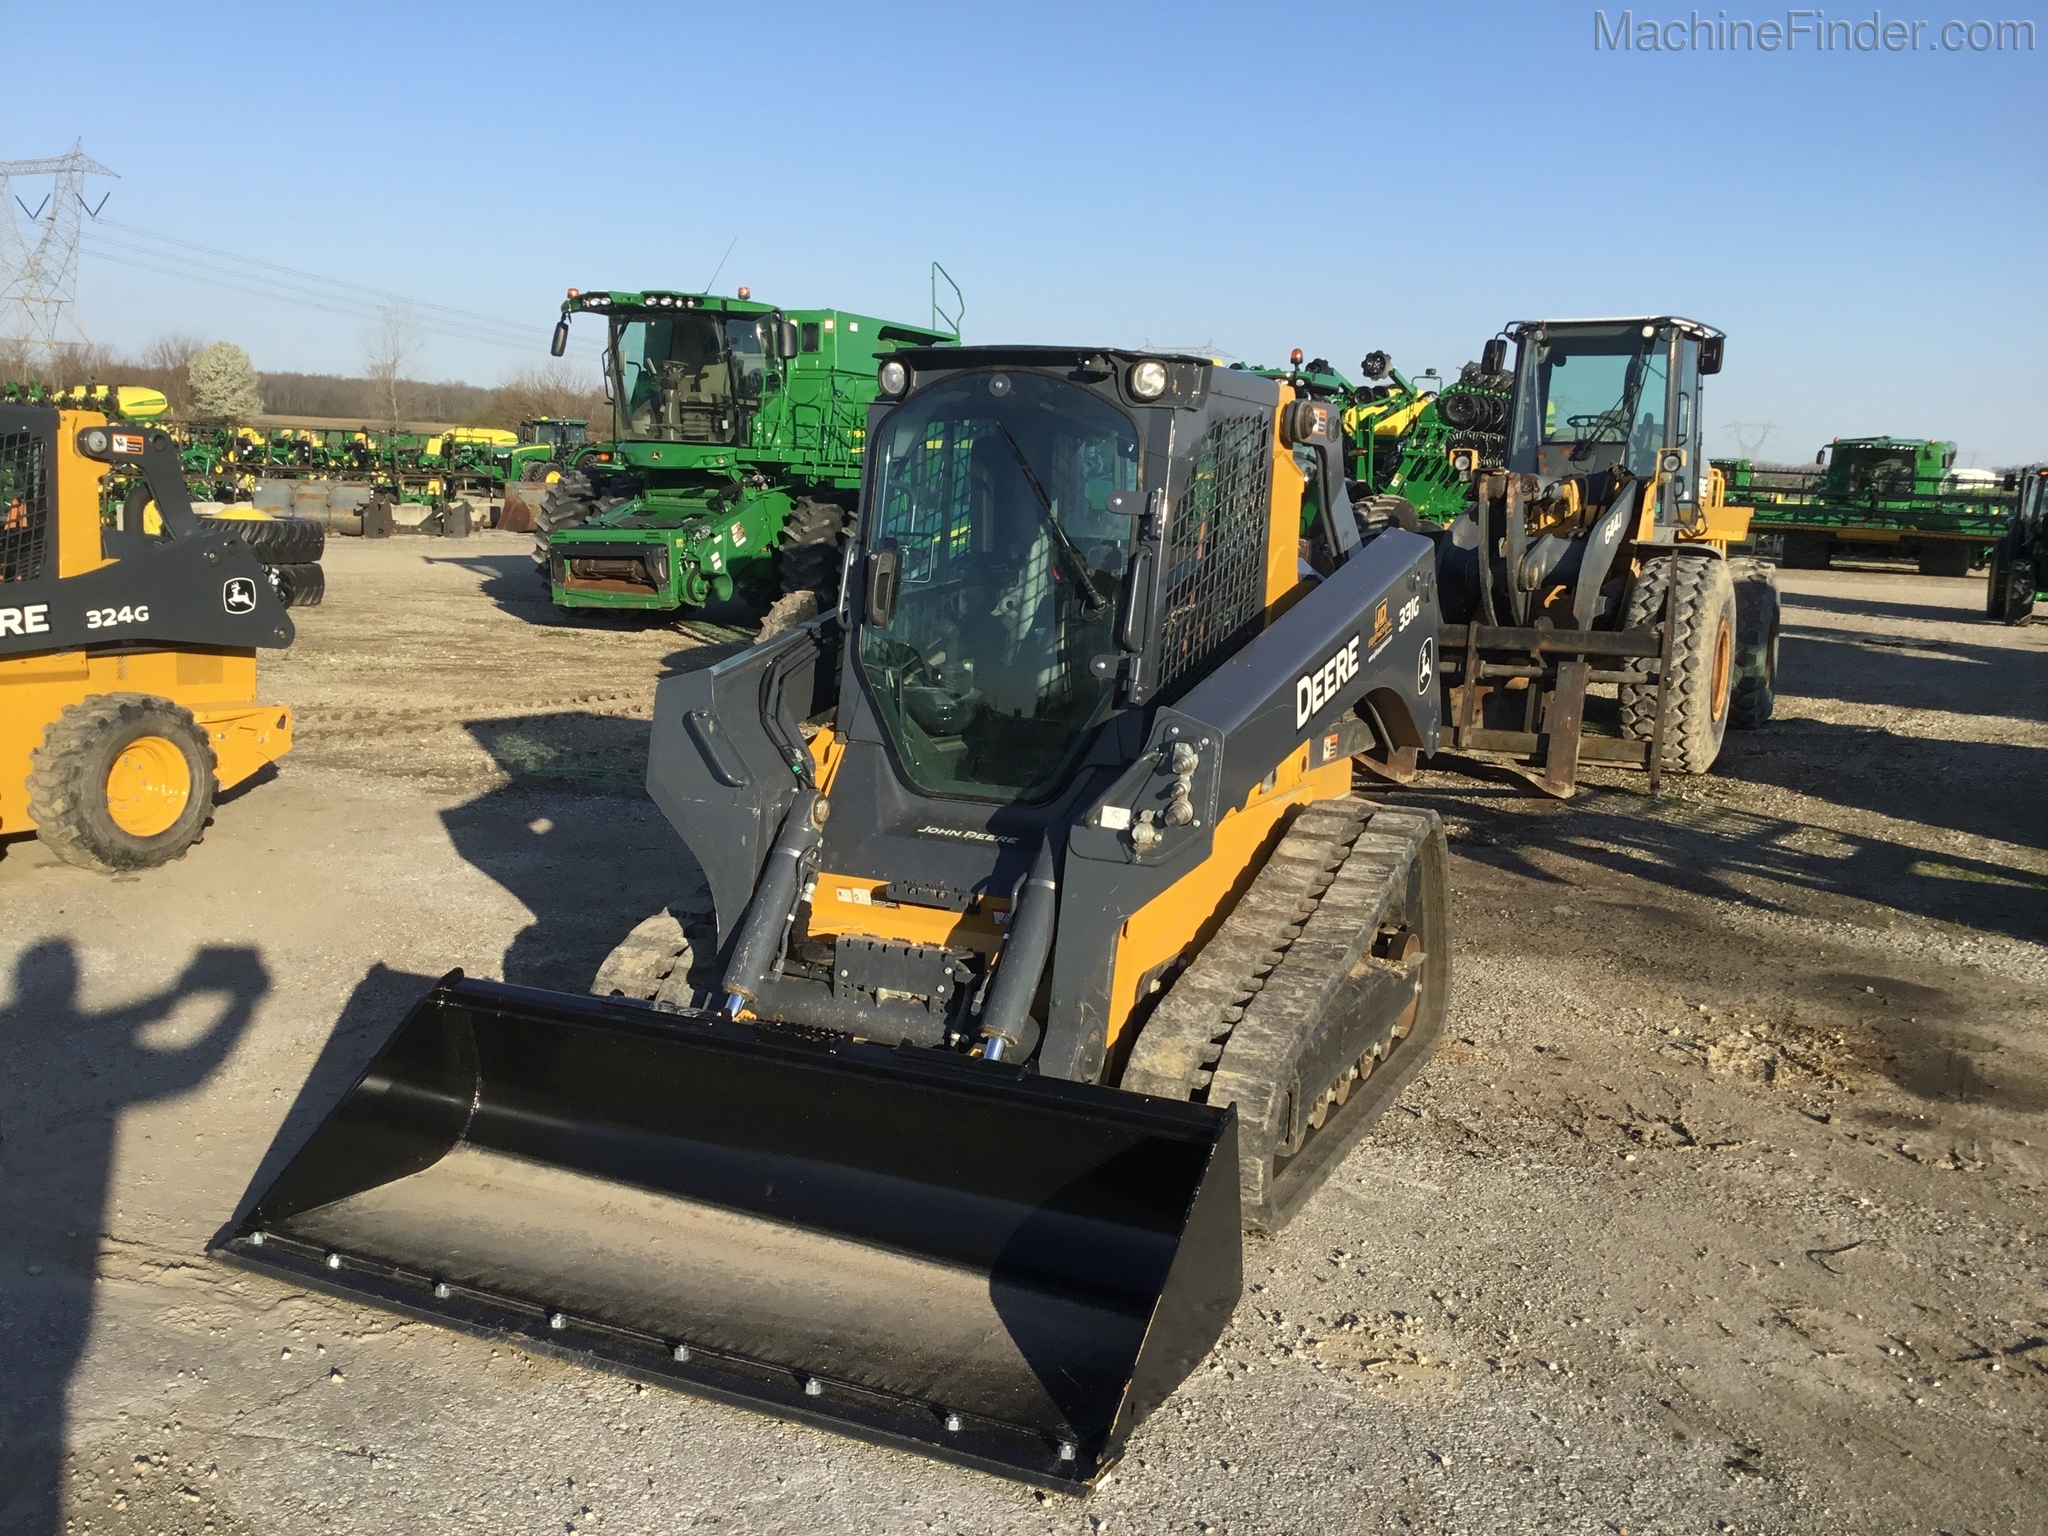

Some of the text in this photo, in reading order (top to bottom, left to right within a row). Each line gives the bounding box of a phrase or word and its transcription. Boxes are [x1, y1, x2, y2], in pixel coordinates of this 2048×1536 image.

[86, 605, 149, 629] 324G
[1398, 595, 1420, 633] 331G
[1296, 635, 1360, 730] DEERE
[917, 825, 1020, 844] JOHN DEERE
